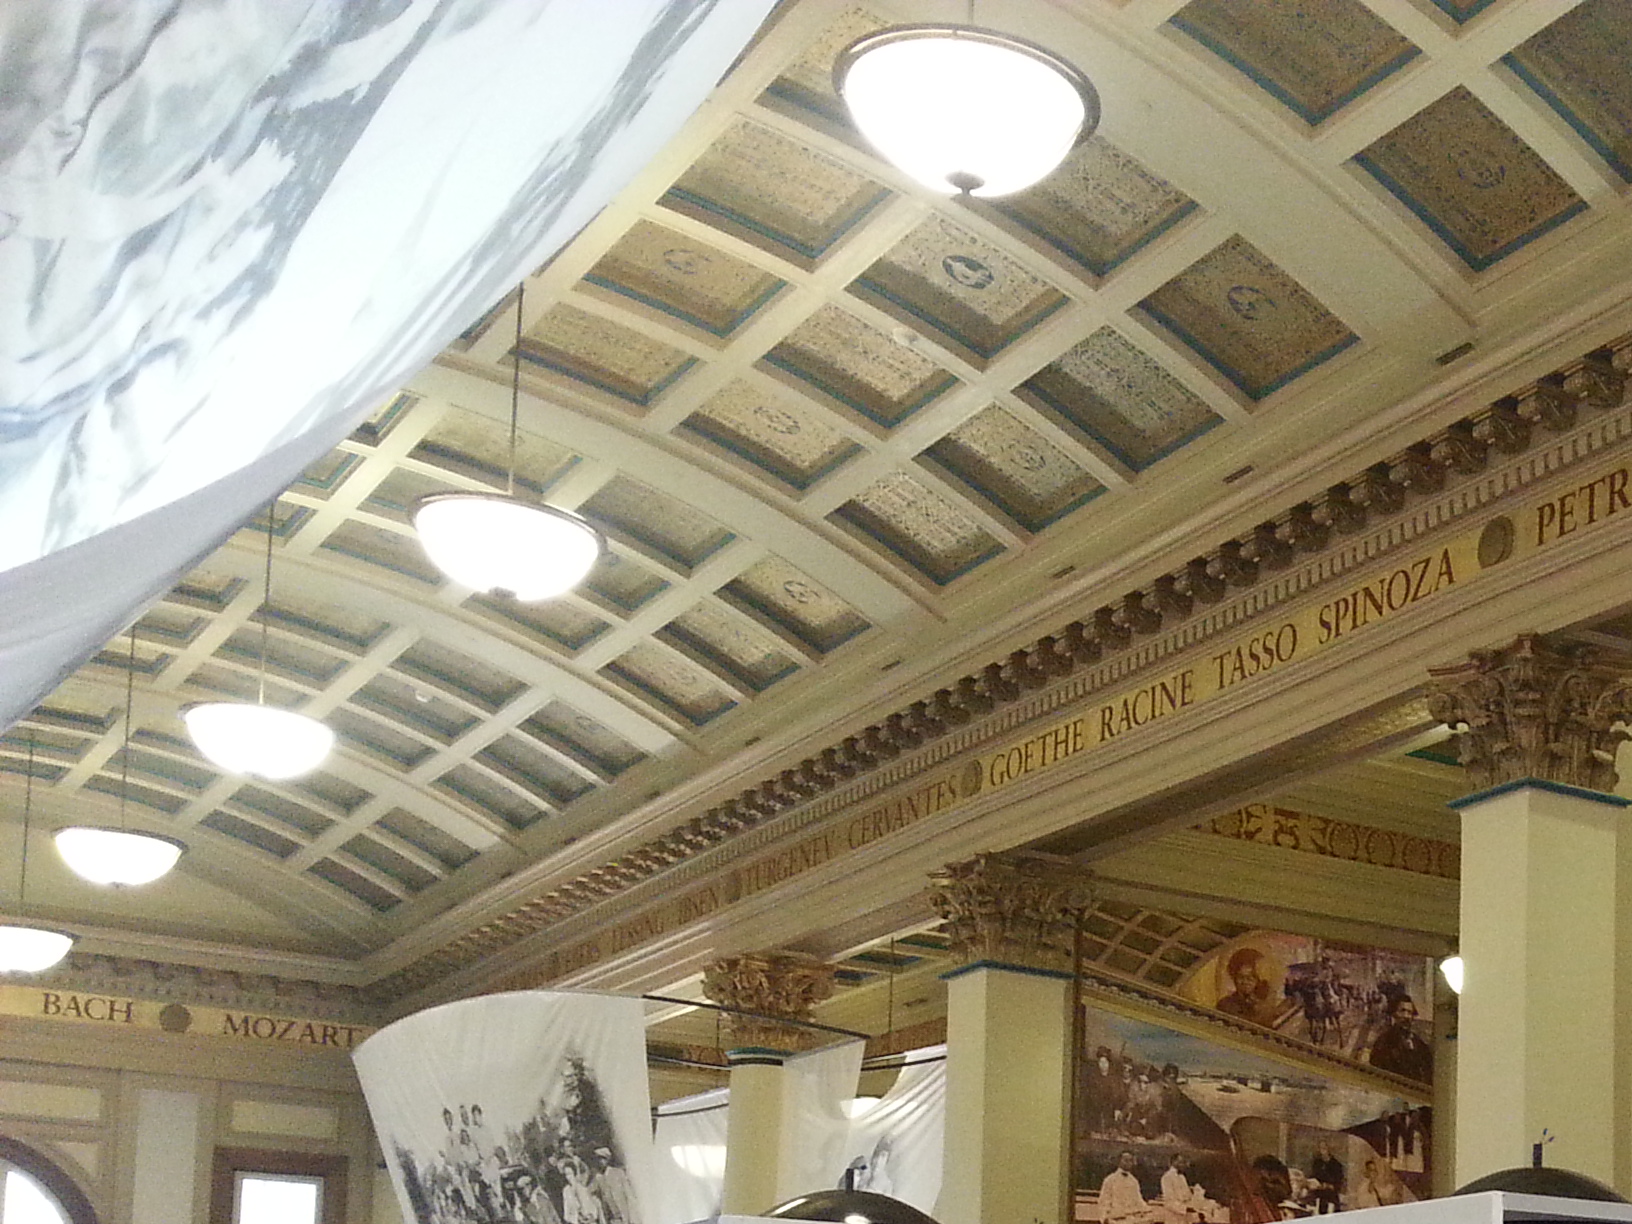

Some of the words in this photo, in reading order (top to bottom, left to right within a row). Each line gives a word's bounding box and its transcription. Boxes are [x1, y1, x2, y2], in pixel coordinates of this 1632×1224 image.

[990, 719, 1085, 787] GOETHE
[1099, 670, 1194, 742] RACINE
[1212, 623, 1298, 690] TASSO
[1317, 547, 1457, 645] SPINOZA
[849, 774, 957, 850] CERVANTES
[42, 992, 134, 1024] BACH
[223, 1013, 363, 1048] MOZART
